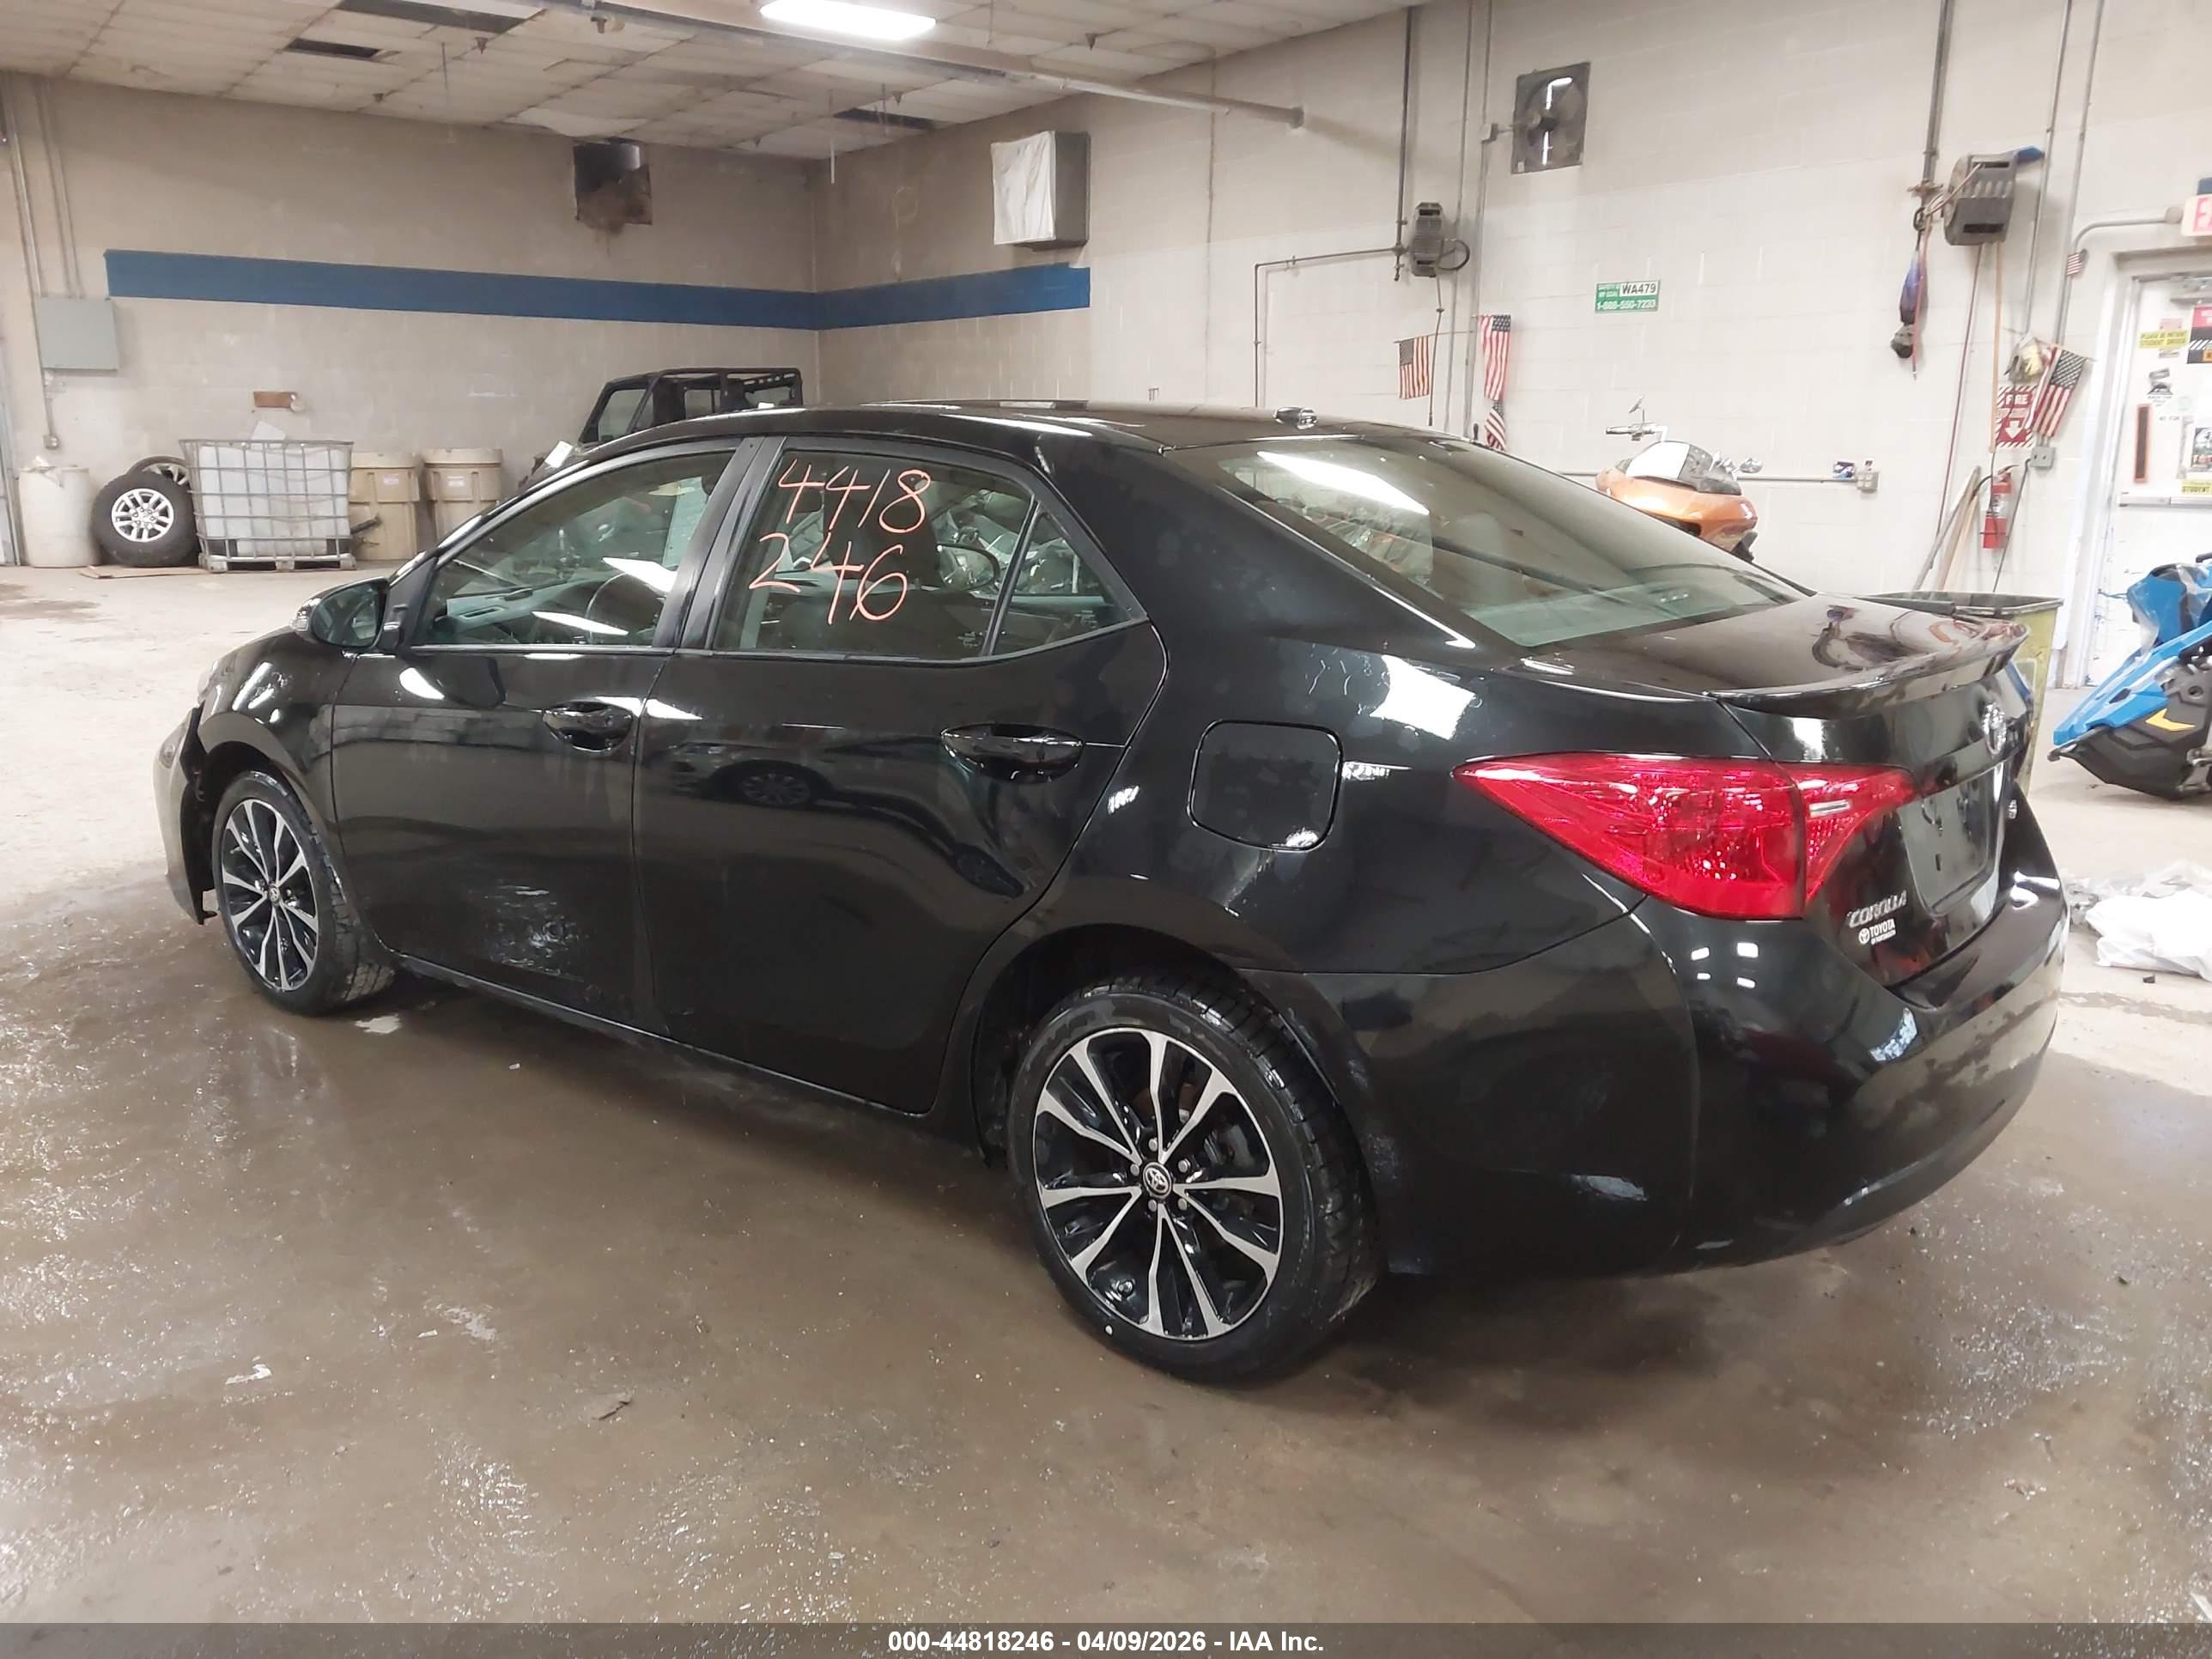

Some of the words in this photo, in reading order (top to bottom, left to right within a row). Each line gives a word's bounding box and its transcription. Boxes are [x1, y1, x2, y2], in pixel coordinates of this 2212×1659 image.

[1622, 283, 1656, 295] WA479
[2005, 393, 2029, 405] FRE
[778, 459, 932, 533] 4418
[749, 532, 908, 625] 246
[1846, 890, 1907, 928] COROLLA
[1869, 918, 1896, 938] TOYOTA
